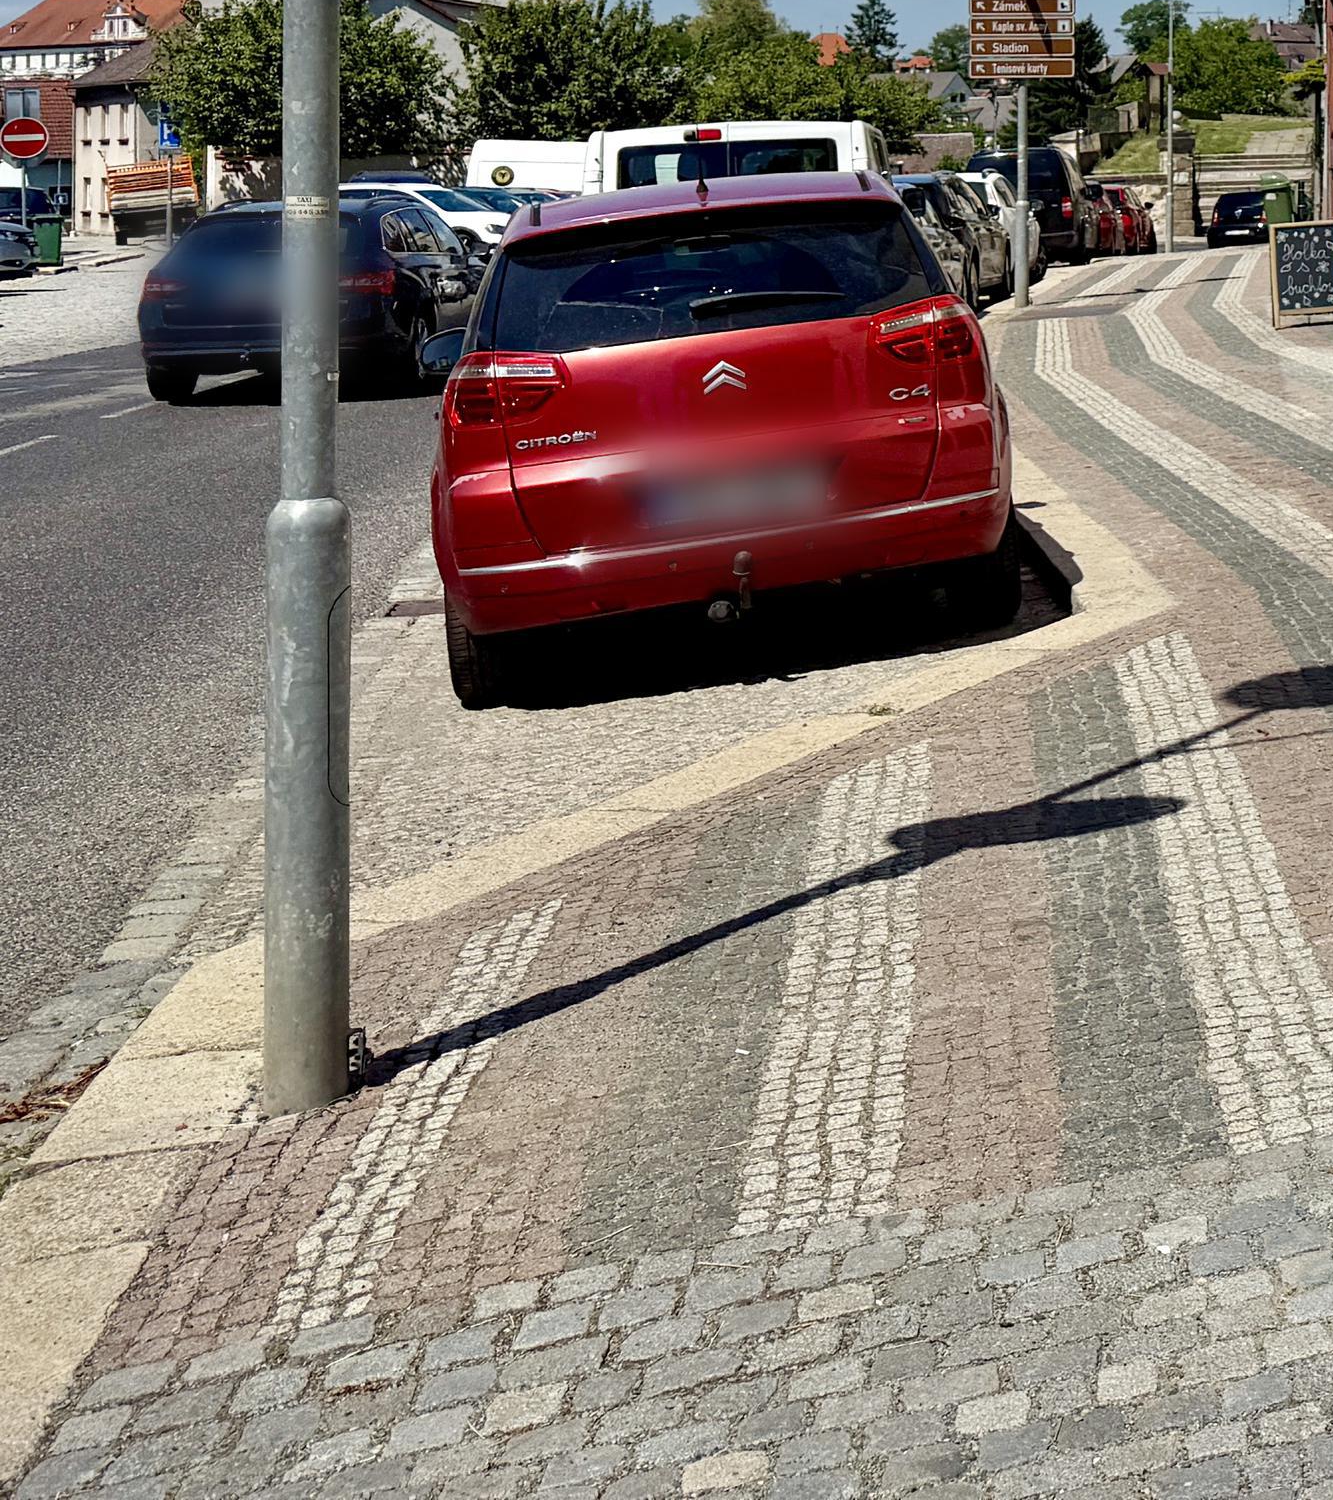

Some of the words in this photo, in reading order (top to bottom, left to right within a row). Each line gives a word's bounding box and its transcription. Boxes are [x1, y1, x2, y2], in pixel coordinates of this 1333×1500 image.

[992, 0, 1028, 11] Zámek
[992, 21, 1015, 33] Kaple
[1016, 23, 1028, 31] sv.
[992, 42, 1029, 53] Stadion
[992, 63, 1025, 74] Tenisové
[1027, 63, 1048, 75] kurty
[1282, 240, 1331, 260] Holka
[888, 383, 931, 400] C4
[515, 430, 597, 450] CITROËN
